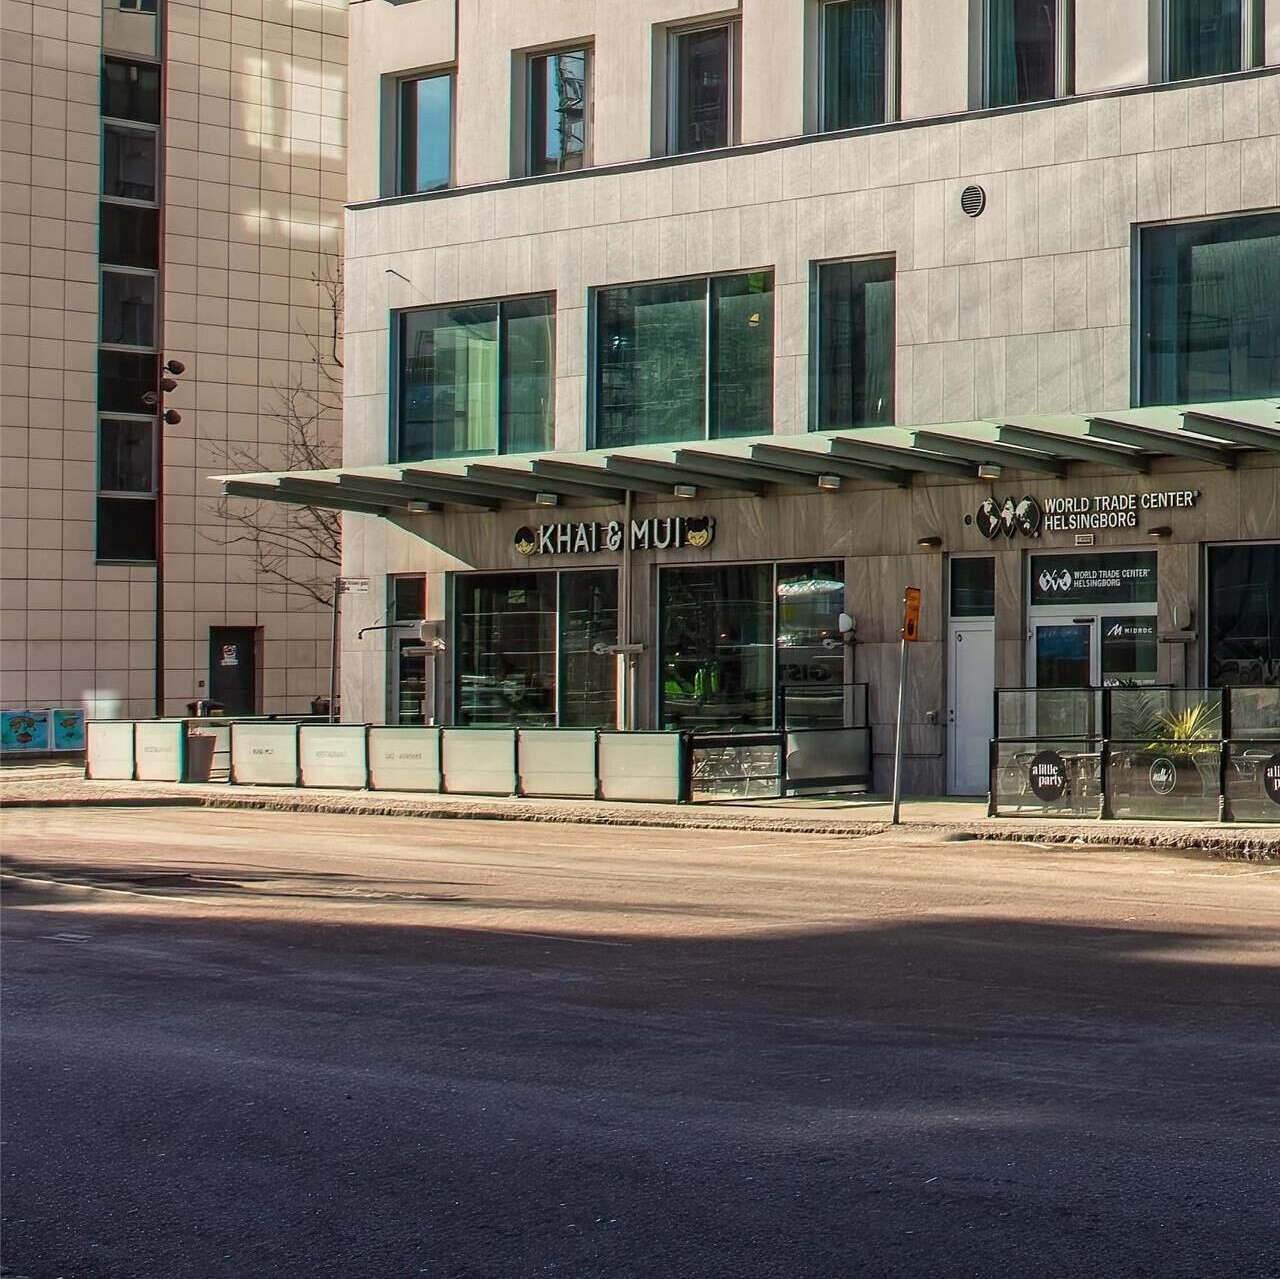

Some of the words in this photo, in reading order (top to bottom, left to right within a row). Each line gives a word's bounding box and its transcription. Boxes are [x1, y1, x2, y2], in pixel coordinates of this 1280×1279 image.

[1044, 497, 1090, 513] WORLD
[1094, 494, 1137, 511] TRADE
[1044, 511, 1137, 531] HELSINGBORG
[540, 522, 597, 554] KHAI
[607, 521, 621, 551] &
[631, 517, 680, 550] MUI
[1073, 570, 1098, 579] WORLD
[1099, 569, 1121, 578] TRADE
[1073, 579, 1121, 588] HELSINGBORG
[1038, 763, 1059, 775] little
[1038, 775, 1064, 787] party
